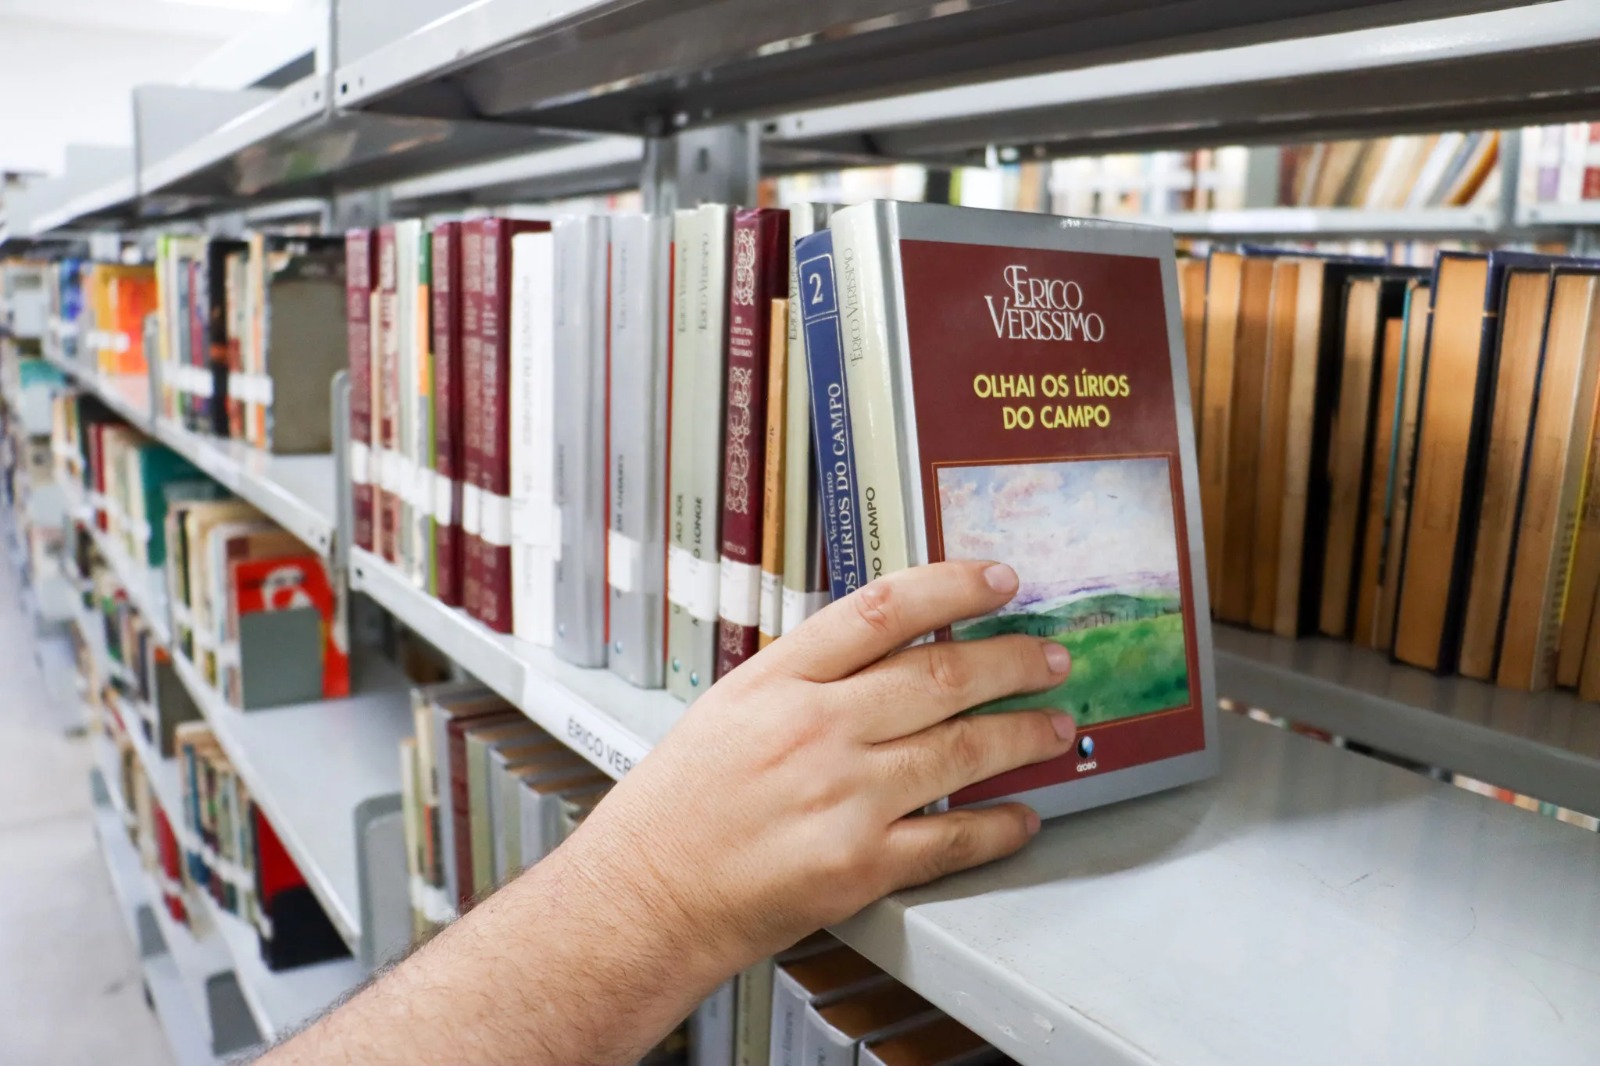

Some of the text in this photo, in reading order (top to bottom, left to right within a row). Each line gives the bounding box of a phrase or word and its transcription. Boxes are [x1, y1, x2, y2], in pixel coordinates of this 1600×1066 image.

[809, 272, 824, 305] 2
[1003, 265, 1083, 310] ERICO
[984, 295, 1105, 342] VERISSIMO
[973, 368, 1130, 398] OLHAI OS LÍRIOS
[827, 383, 847, 456] CAMPO
[1003, 405, 1111, 429] DO CAMPO
[834, 461, 849, 490] DO
[865, 486, 881, 551] CAMPO
[832, 543, 842, 581] Erico
